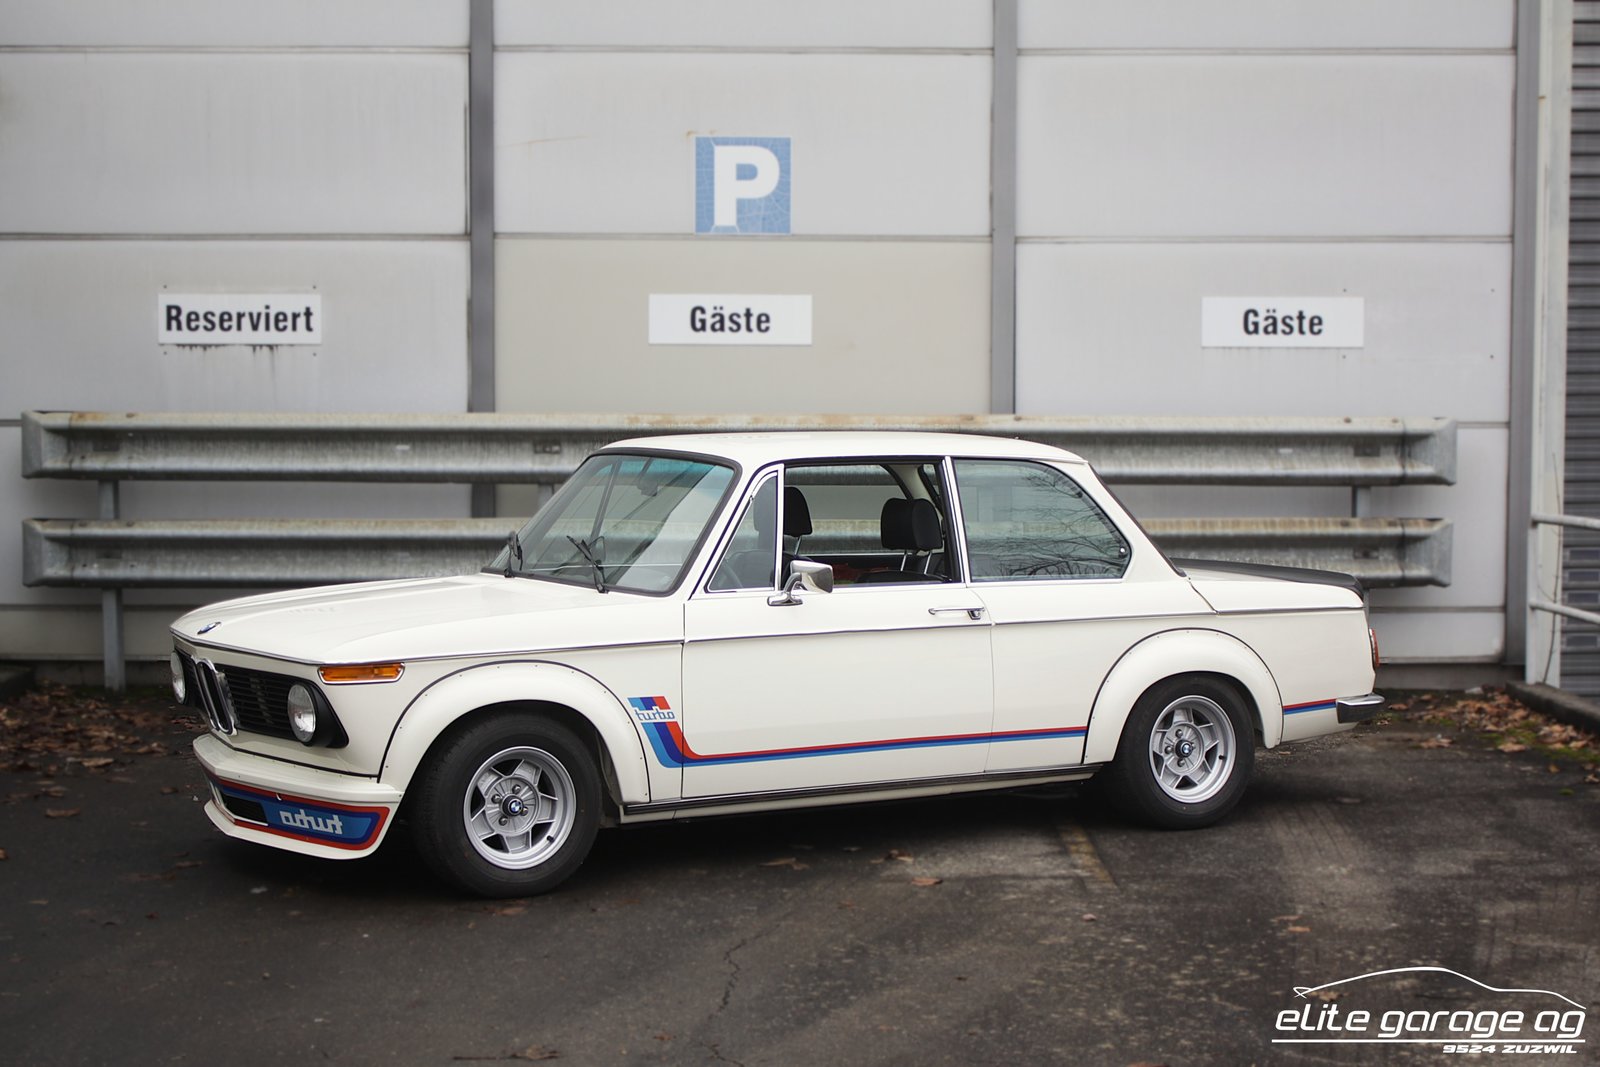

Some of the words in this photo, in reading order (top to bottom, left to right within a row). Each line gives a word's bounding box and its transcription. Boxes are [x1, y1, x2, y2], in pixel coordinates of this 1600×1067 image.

[713, 145, 781, 226] P
[165, 304, 314, 332] Reserviert
[689, 305, 771, 333] Gäste
[1243, 308, 1324, 336] Gäste
[633, 706, 676, 721] turbo
